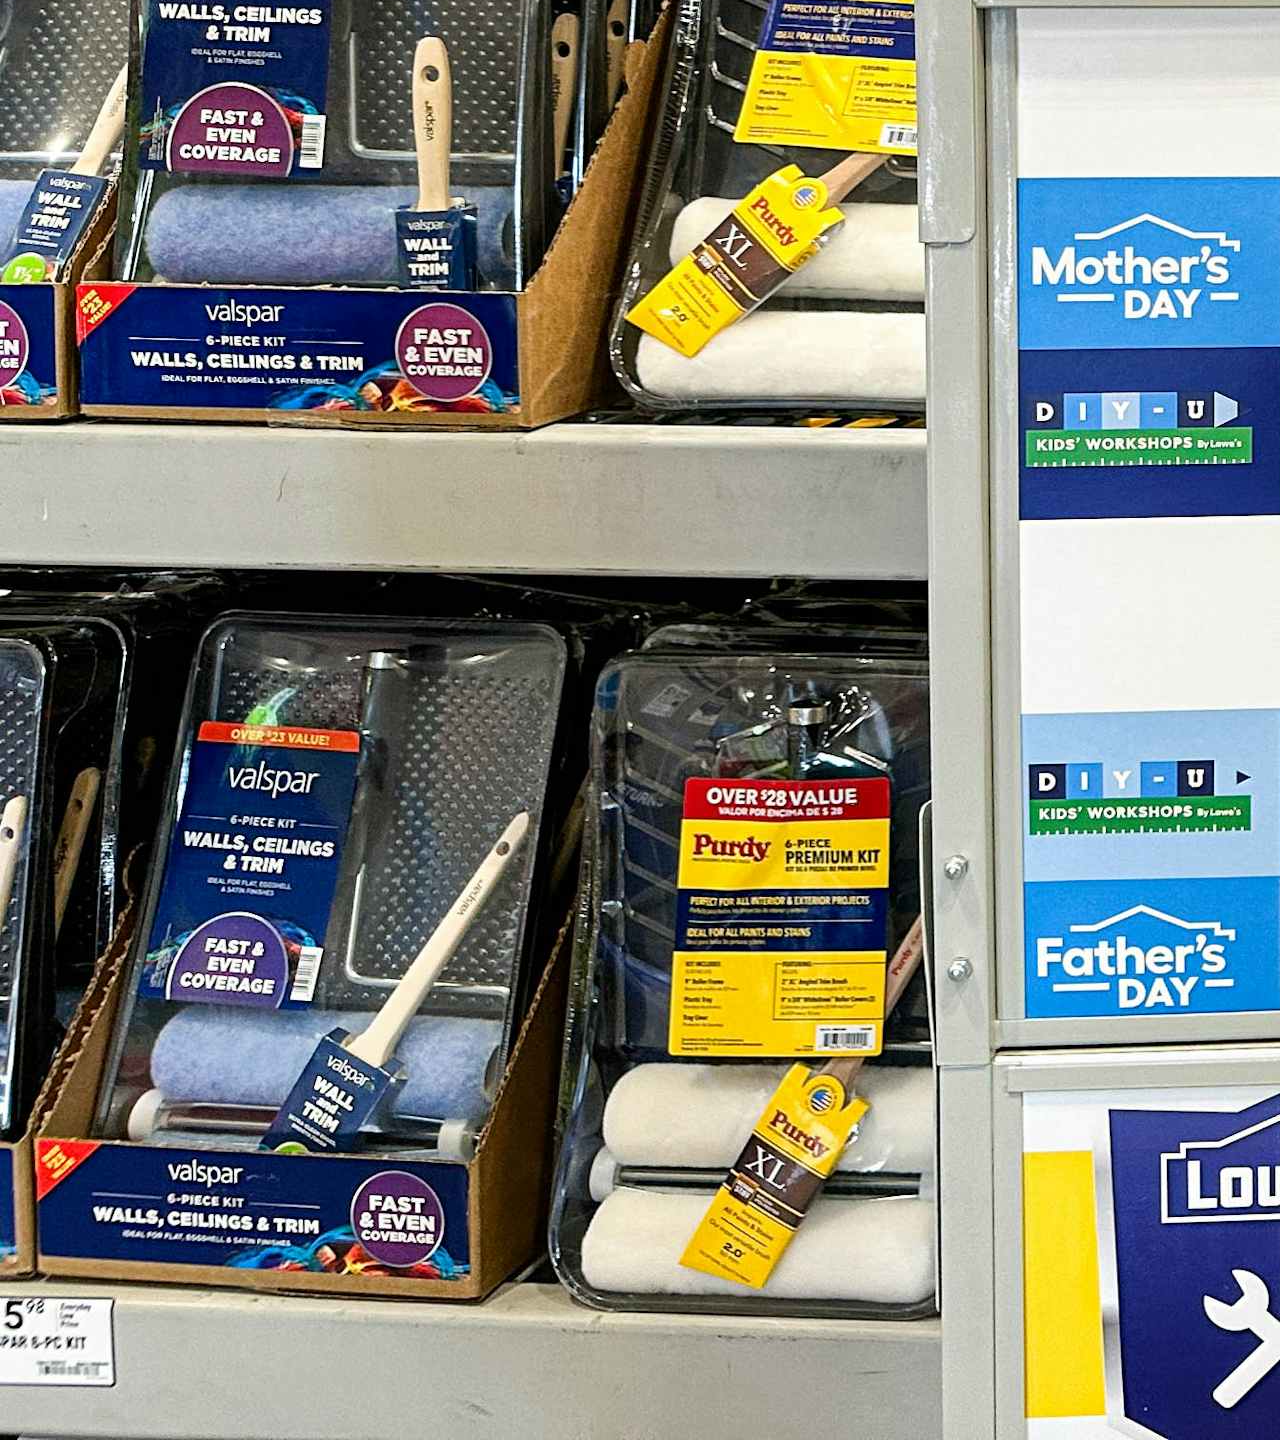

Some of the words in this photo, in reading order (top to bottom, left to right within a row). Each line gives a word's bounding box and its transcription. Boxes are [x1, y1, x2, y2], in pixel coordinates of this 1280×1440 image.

[159, 3, 230, 23] WALLS,
[234, 5, 322, 25] CEILINGS
[206, 25, 220, 41] &
[223, 26, 271, 43] TRIM
[200, 110, 249, 126] FAST
[251, 112, 264, 126] &
[206, 127, 256, 144] EVEN
[179, 144, 281, 163] COVERAGE
[1033, 244, 1230, 288] Mother's
[1124, 287, 1202, 320] DAY
[1035, 435, 1082, 453] KIDS'
[1085, 433, 1194, 453] WORKSHOPS
[706, 788, 758, 805] OVER
[760, 788, 787, 806] $28
[789, 788, 857, 805] VALUE
[1037, 805, 1084, 822] KIDS'
[1085, 804, 1194, 820] WORKSHOPS
[693, 832, 772, 862] Purdy
[786, 850, 853, 864] PREMIUM
[857, 849, 881, 863] KIT
[1036, 933, 1226, 977] Father's
[1118, 976, 1199, 1010] DAY
[745, 1145, 786, 1190] XL
